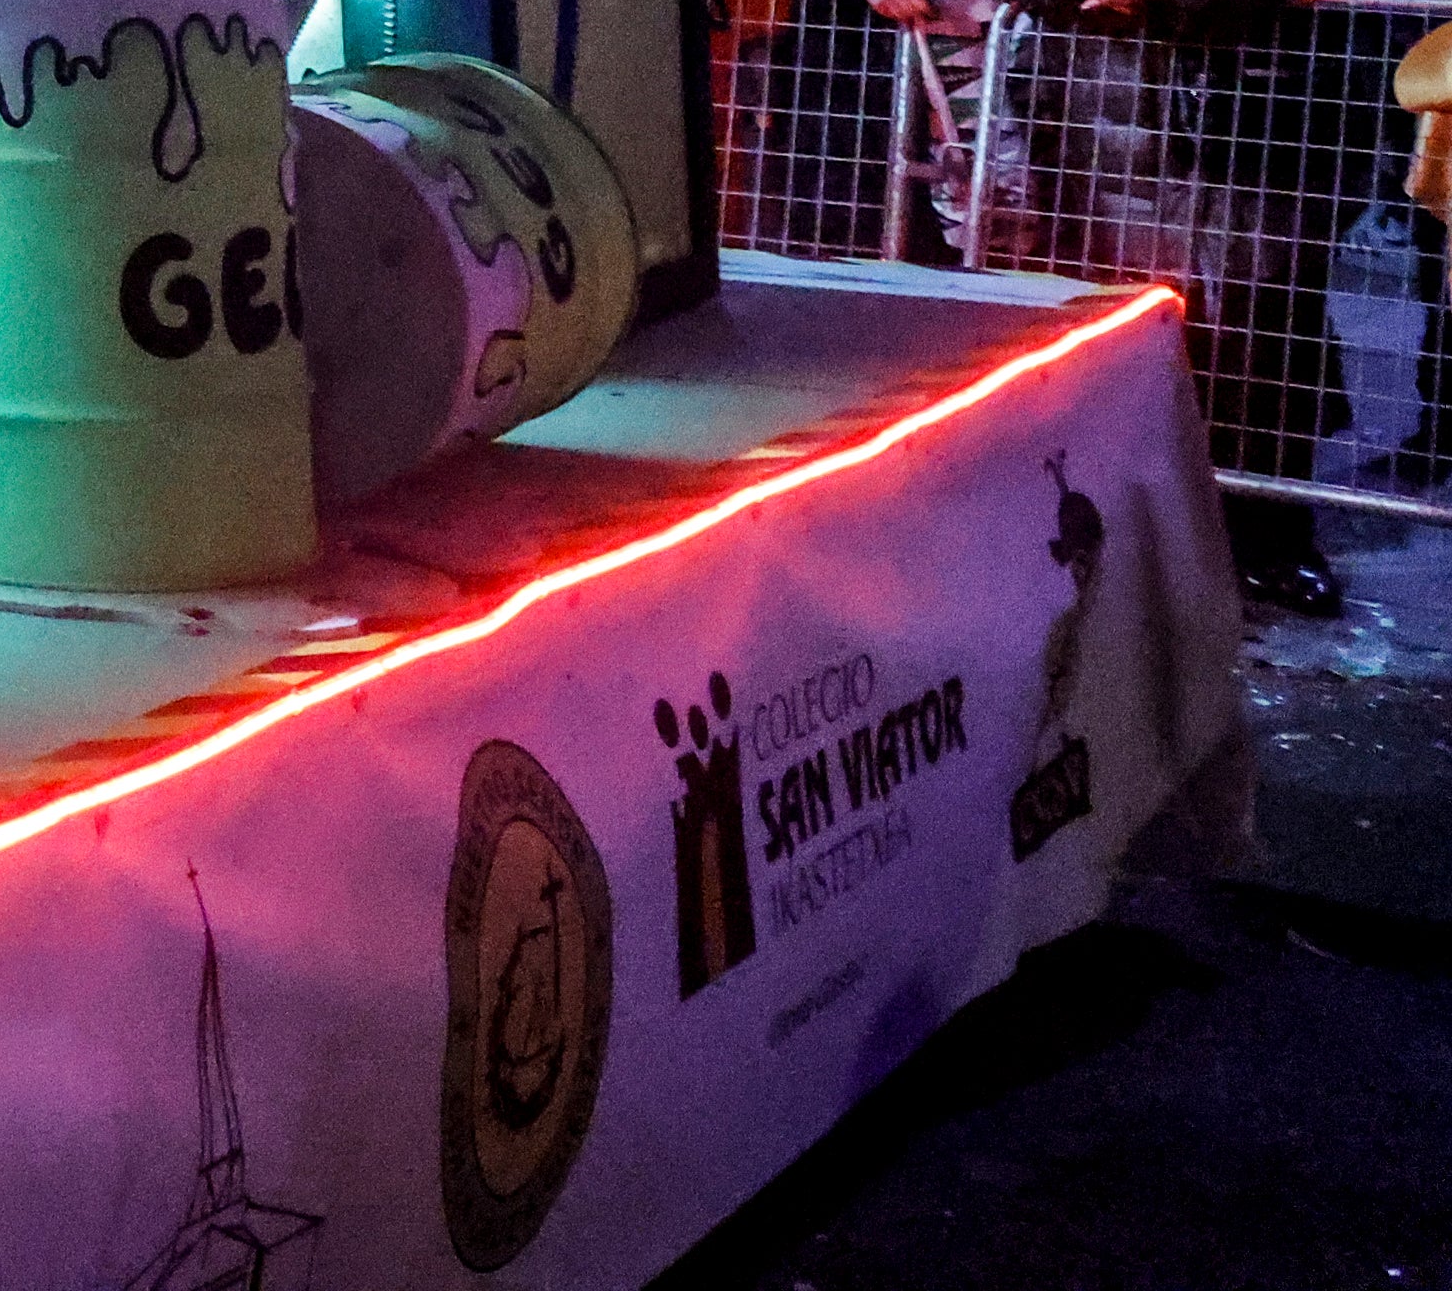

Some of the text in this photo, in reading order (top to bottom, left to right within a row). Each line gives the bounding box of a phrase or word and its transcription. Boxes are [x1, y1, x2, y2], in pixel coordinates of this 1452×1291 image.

[751, 654, 874, 760] COLEGIO
[758, 749, 834, 862] SAN
[838, 676, 968, 809] VIATOR
